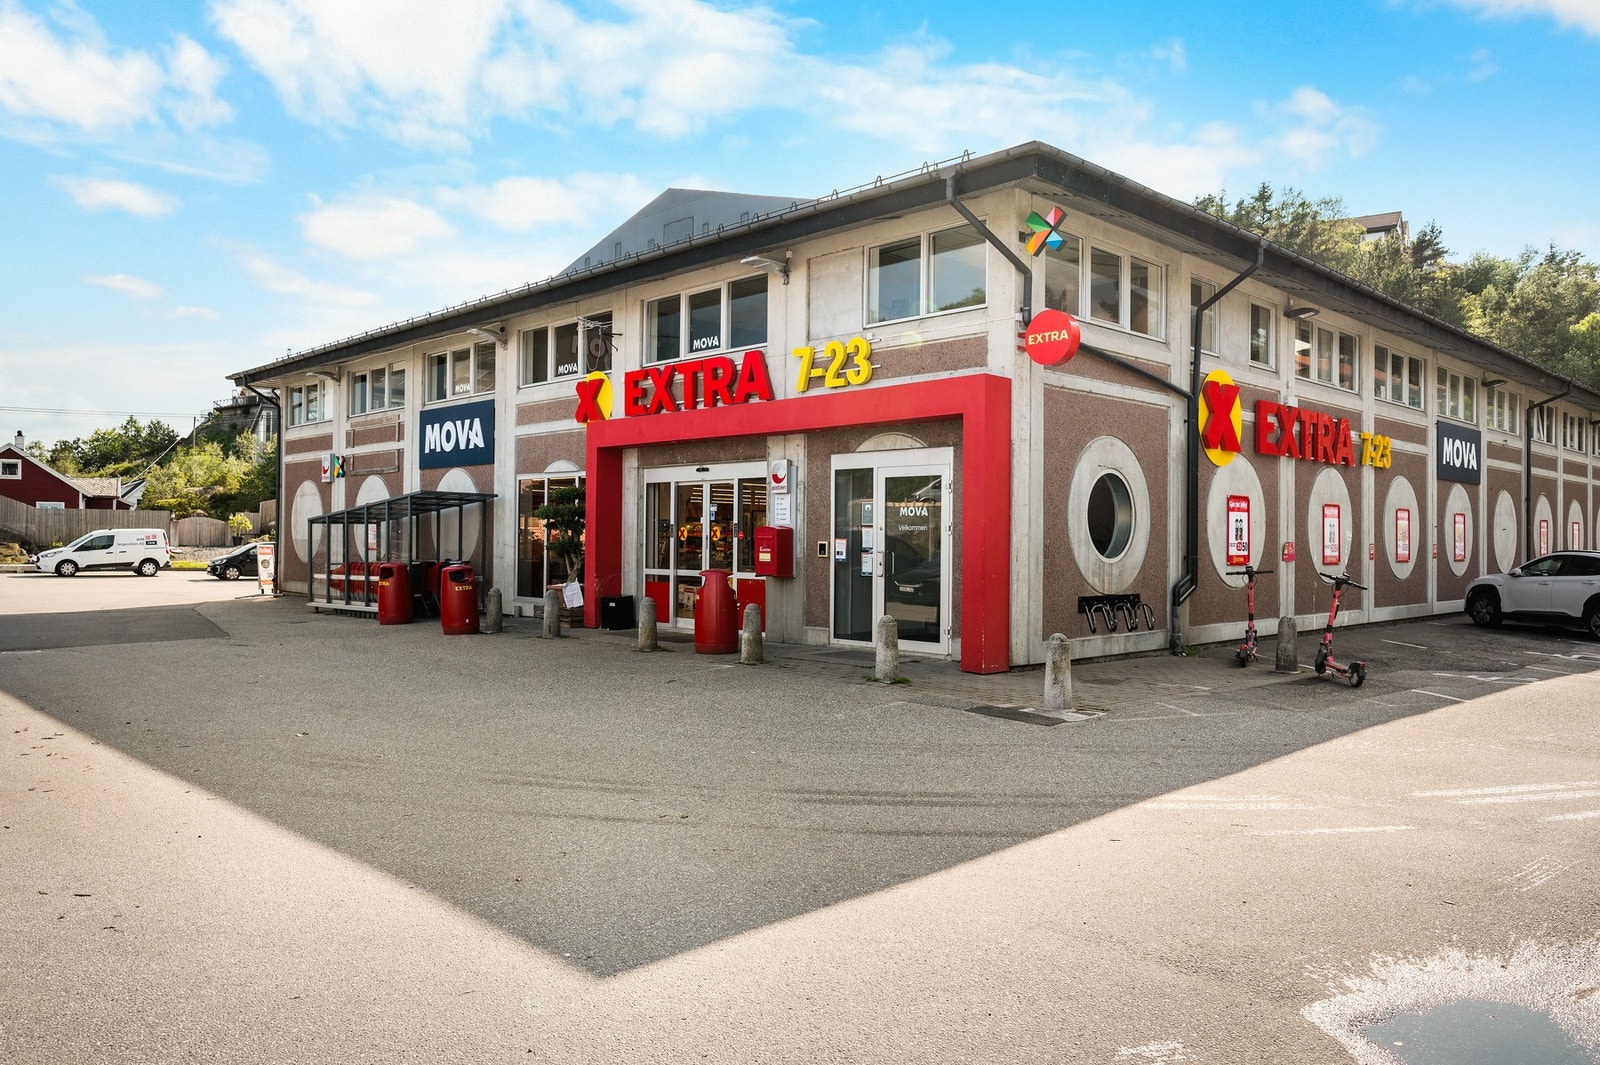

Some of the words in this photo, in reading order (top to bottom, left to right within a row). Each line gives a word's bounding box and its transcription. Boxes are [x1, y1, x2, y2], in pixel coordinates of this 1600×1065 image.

[693, 335, 720, 350] MOVA
[1028, 329, 1069, 345] EXTRA
[557, 362, 578, 375] MOVA
[624, 350, 775, 417] EXTRA
[792, 336, 873, 392] 7-23
[455, 383, 470, 393] MOVA
[424, 418, 485, 454] MOVA
[1255, 399, 1356, 467] EXTRA
[1360, 431, 1392, 469] 7-23
[1442, 436, 1478, 470] MOVA
[899, 506, 928, 517] MOVA
